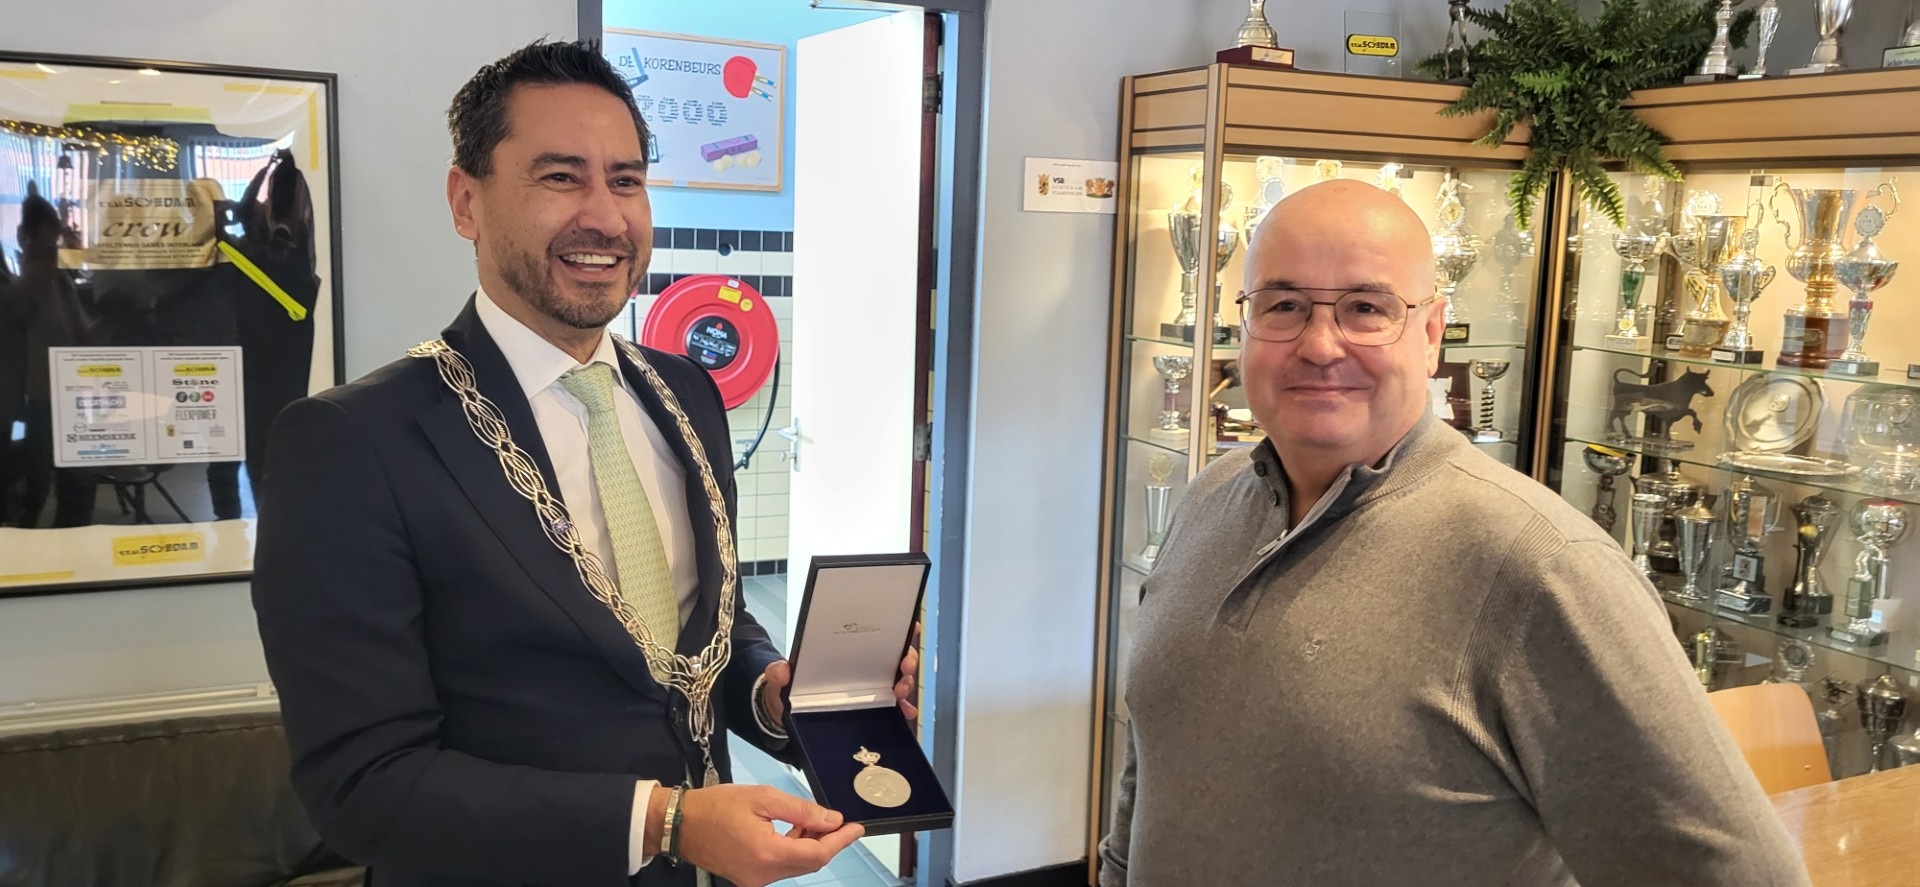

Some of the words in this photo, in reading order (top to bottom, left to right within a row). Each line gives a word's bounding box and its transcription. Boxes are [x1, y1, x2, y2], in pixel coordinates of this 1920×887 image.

[619, 55, 635, 68] DE
[643, 57, 721, 75] KORENBEURS
[103, 222, 186, 238] crew
